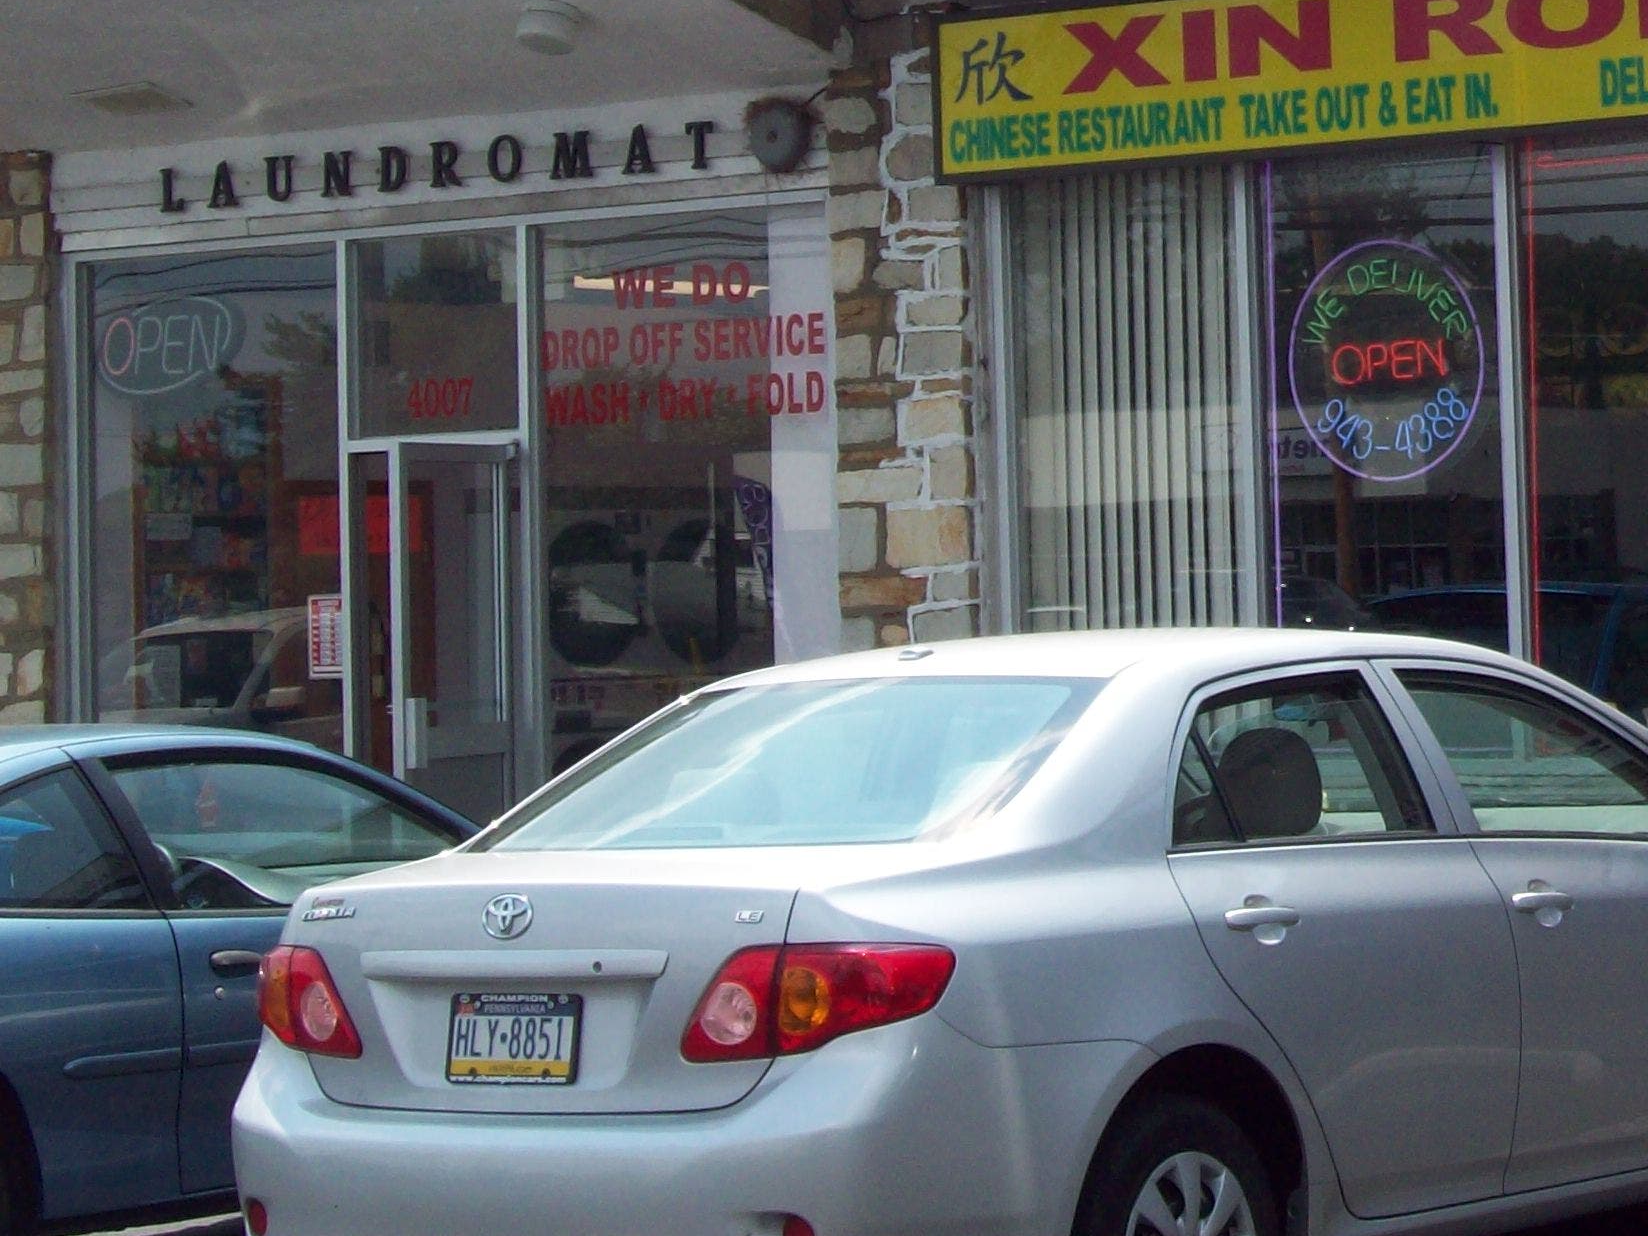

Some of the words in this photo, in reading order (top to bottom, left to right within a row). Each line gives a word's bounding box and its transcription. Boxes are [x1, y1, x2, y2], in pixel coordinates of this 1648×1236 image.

[954, 32, 1033, 105] 欣
[950, 111, 1051, 164] CHINESE
[1059, 96, 1225, 152] RESTAURANT
[1239, 88, 1307, 137] TAKE
[1315, 83, 1369, 127] OUT
[1378, 87, 1398, 121] &
[1406, 76, 1457, 123] EAT
[160, 121, 713, 212] LAUNDROMAT
[612, 267, 676, 309] WE
[692, 262, 751, 306] DO
[1302, 288, 1346, 344] WE
[1347, 259, 1468, 339] DELIVER
[104, 315, 222, 375] OPEN
[540, 327, 620, 370] DROP
[629, 322, 683, 364] OFF
[694, 313, 825, 362] SERVICE
[1331, 338, 1449, 386] OPEN
[407, 375, 474, 418] 4007
[544, 383, 629, 428] WASH
[658, 377, 718, 421] DRY
[746, 371, 824, 416] FOLD
[1317, 388, 1470, 459] 943-4388
[735, 910, 765, 923] LE
[481, 994, 549, 1003] CHAMPION
[485, 1004, 547, 1014] PENNSYLVANIA
